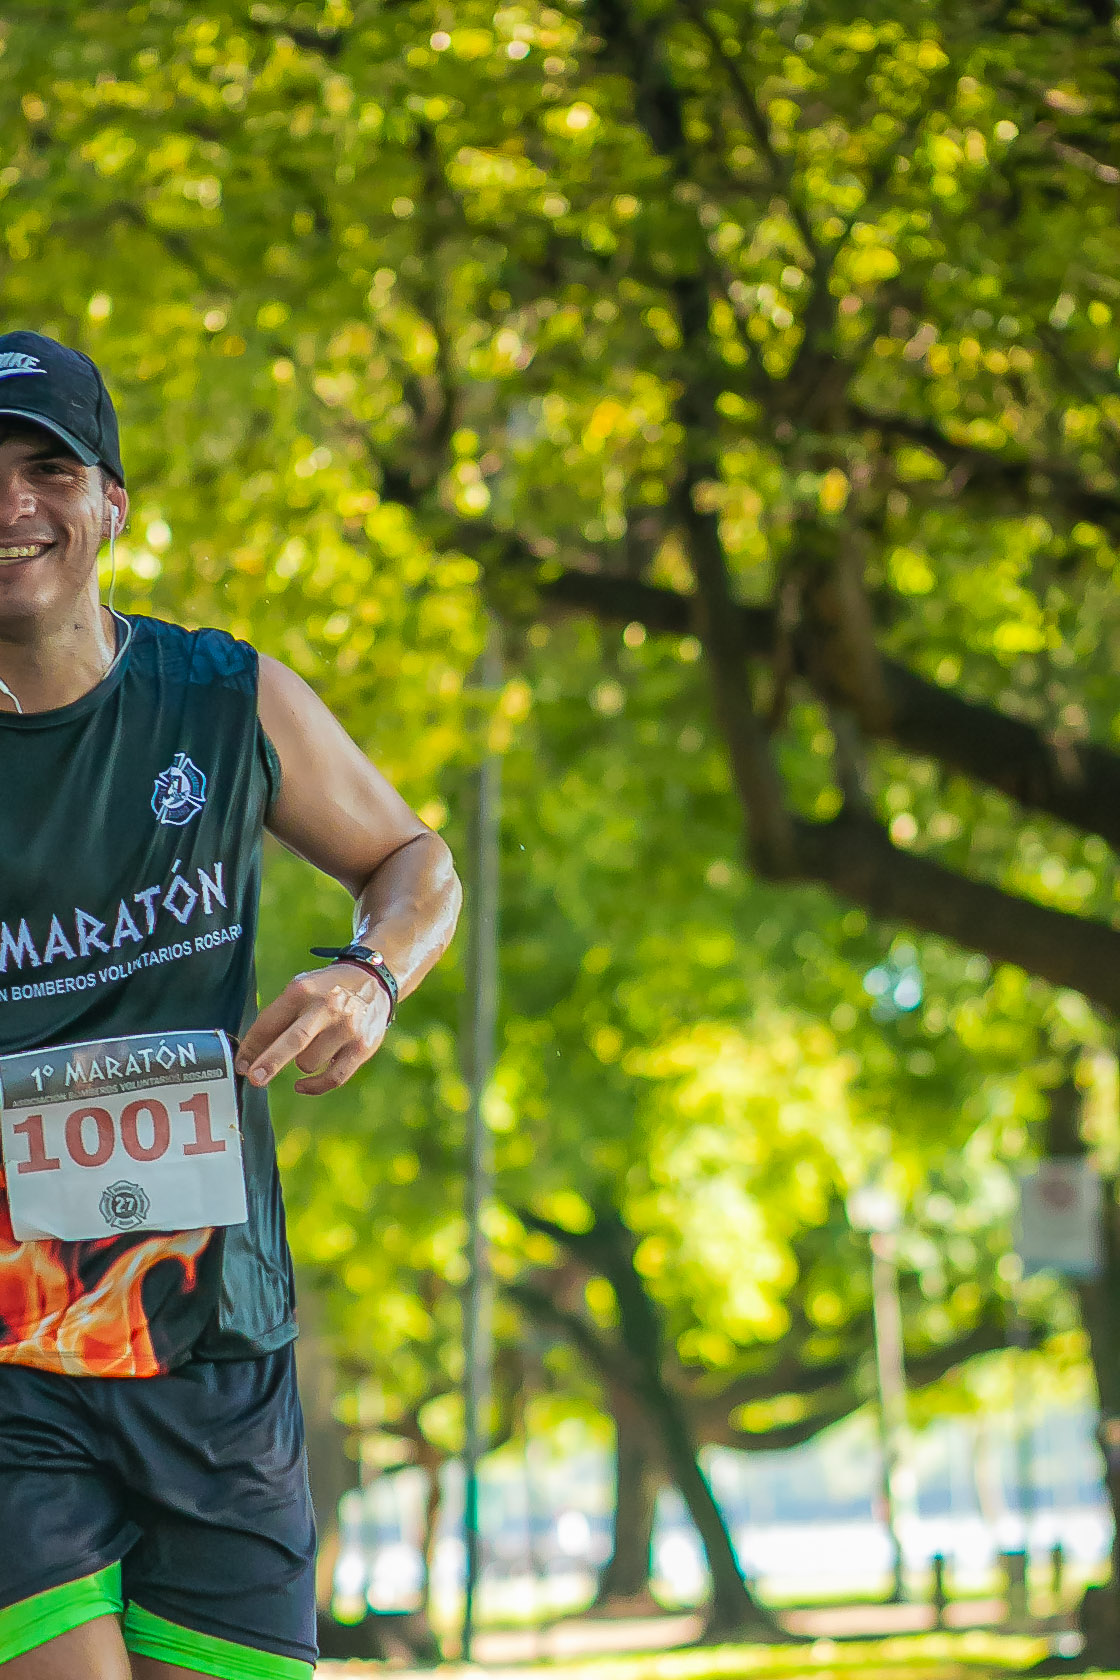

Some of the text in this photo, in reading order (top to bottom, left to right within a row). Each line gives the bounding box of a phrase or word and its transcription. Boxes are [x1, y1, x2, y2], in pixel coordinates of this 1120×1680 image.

[11, 973, 97, 1002] BOMBEROS
[65, 1039, 198, 1087] MARATÓN
[13, 1092, 227, 1174] 1001
[114, 1196, 135, 1214] 27
